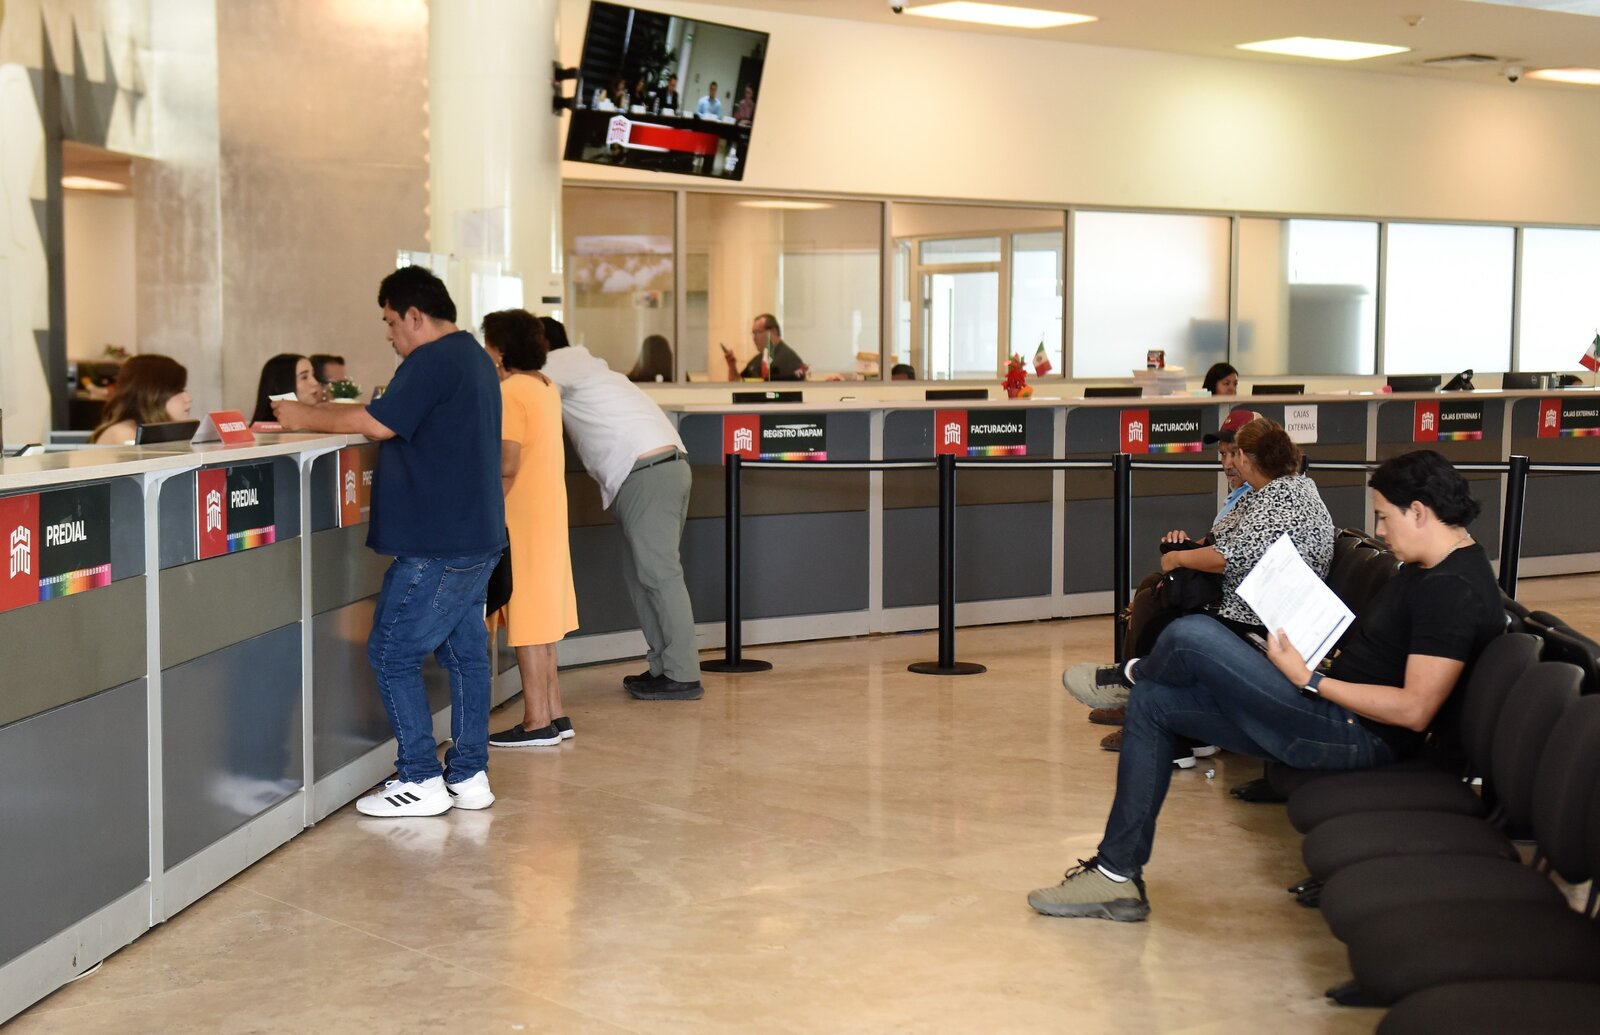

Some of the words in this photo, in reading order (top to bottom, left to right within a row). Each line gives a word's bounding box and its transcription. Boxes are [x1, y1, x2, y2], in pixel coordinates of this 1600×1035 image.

[1293, 410, 1310, 418] CAJAS
[1456, 412, 1478, 420] EXTERNAS
[970, 422, 1017, 434] FACTURACIÓN
[1018, 424, 1023, 433] 2
[1151, 420, 1195, 432] FACTURACIÓN
[1195, 422, 1199, 431] 1
[1287, 423, 1316, 431] EXTERNAS
[763, 429, 797, 439] REGISTRO
[797, 428, 823, 438] INAPAM
[231, 488, 259, 508] PREDIAL
[46, 520, 87, 547] PREDIAL
